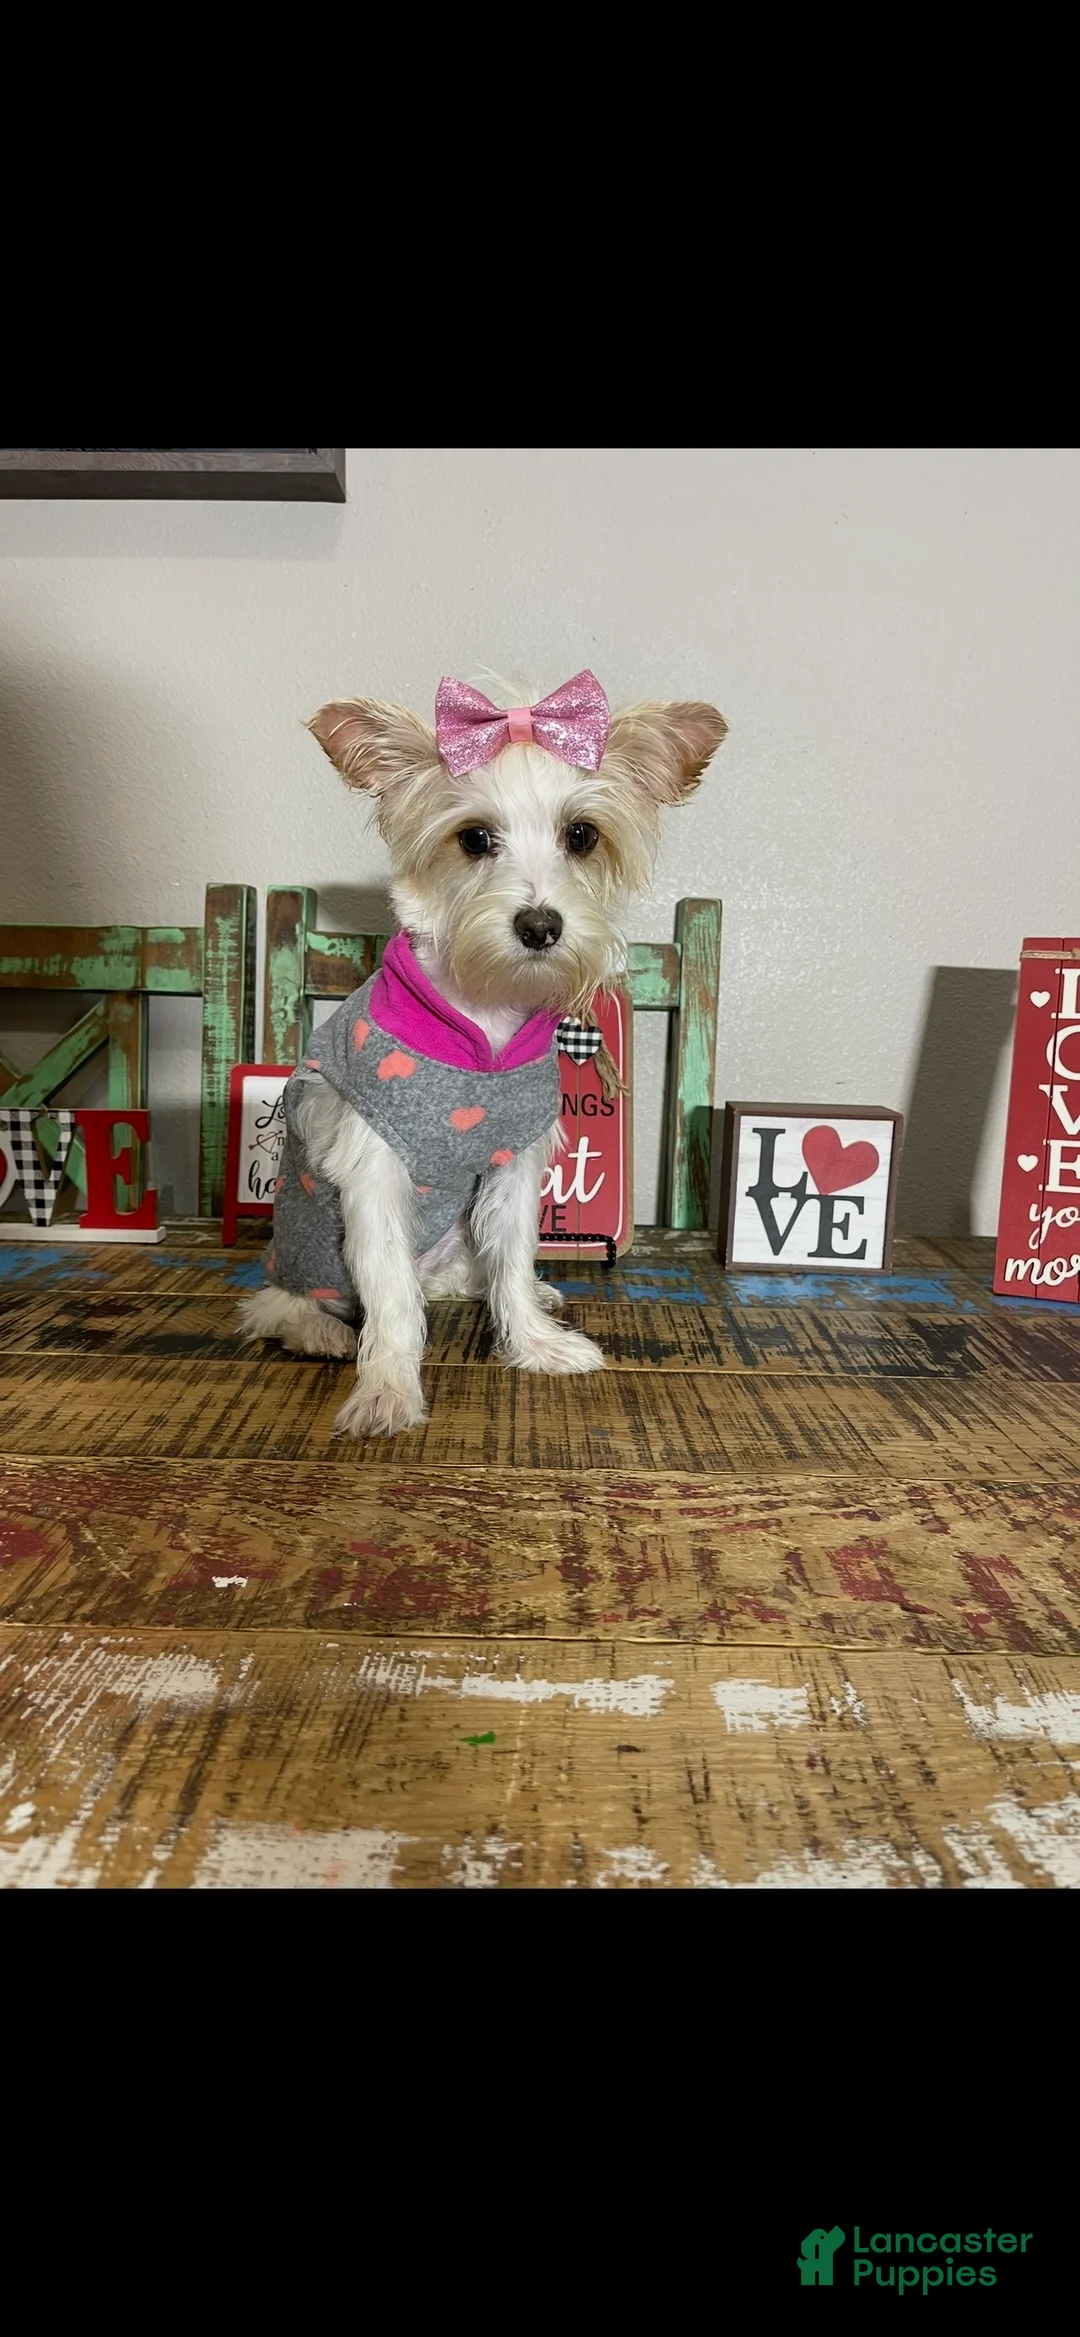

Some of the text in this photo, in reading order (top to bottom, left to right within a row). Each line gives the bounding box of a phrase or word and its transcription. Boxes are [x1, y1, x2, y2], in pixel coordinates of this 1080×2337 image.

[561, 1093, 615, 1117] NGS
[0, 1109, 158, 1230] VE
[540, 1136, 606, 1204] at
[1028, 1203, 1080, 1250] yo
